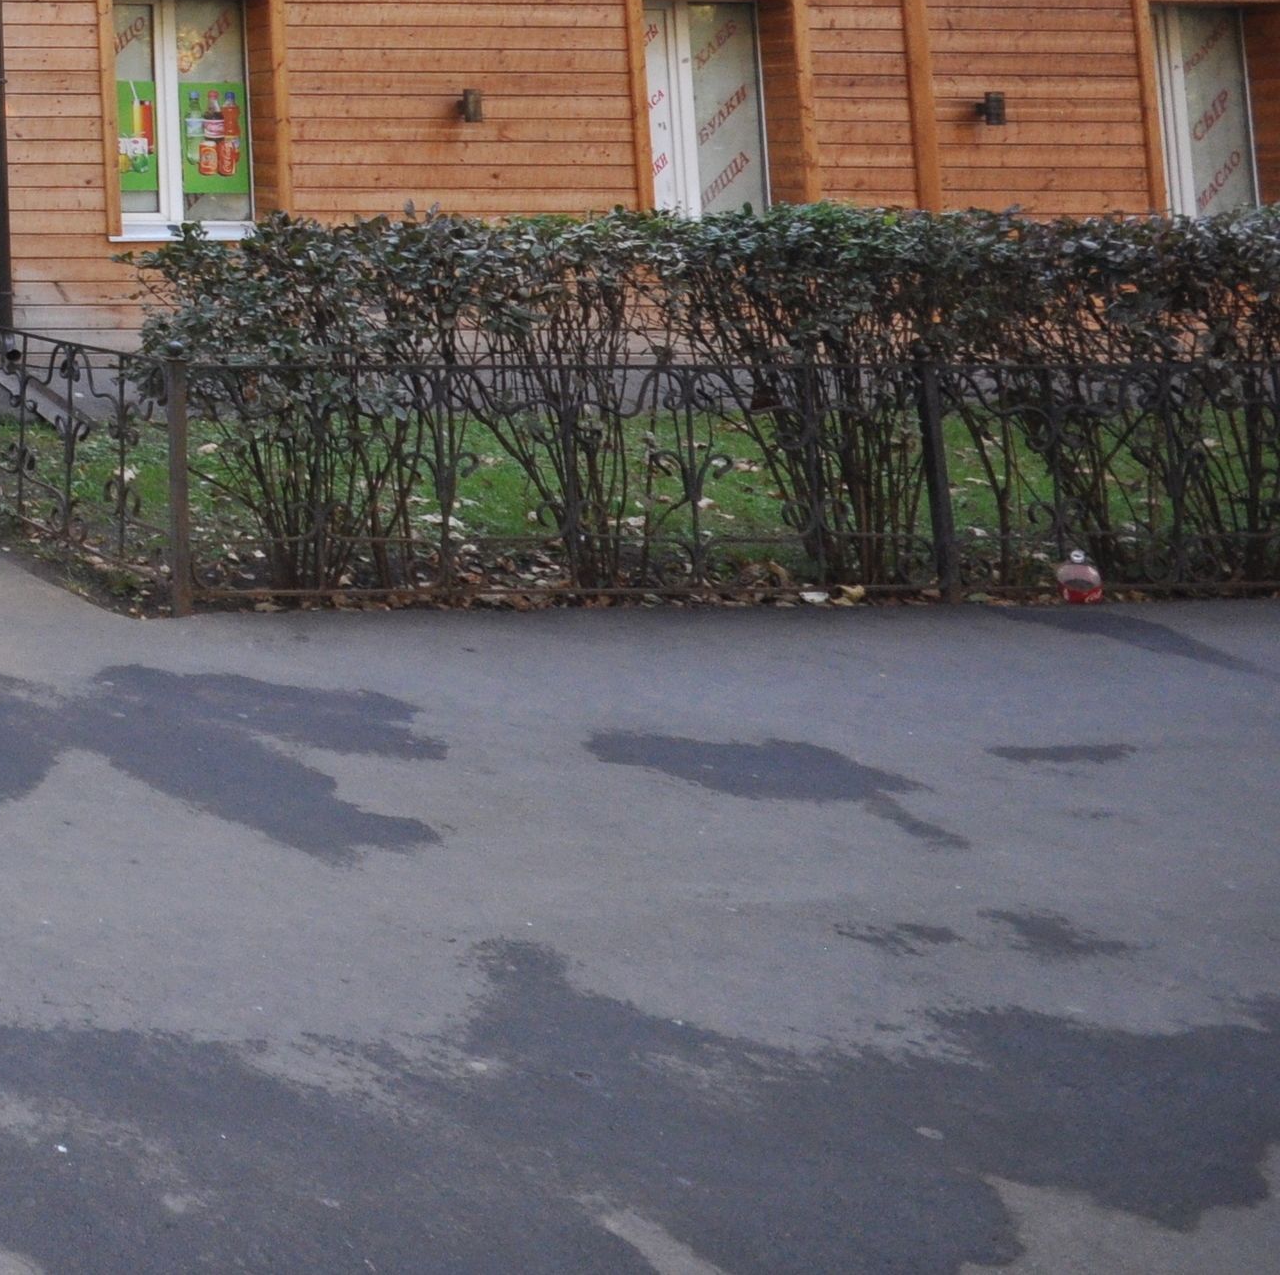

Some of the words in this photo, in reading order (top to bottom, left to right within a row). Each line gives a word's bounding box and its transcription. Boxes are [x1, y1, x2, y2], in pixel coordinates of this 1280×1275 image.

[694, 18, 740, 70] ХЛЕБ
[699, 84, 748, 146] БУЛКИ
[1192, 88, 1229, 142] СЫР
[1197, 148, 1241, 211] МАСЛО
